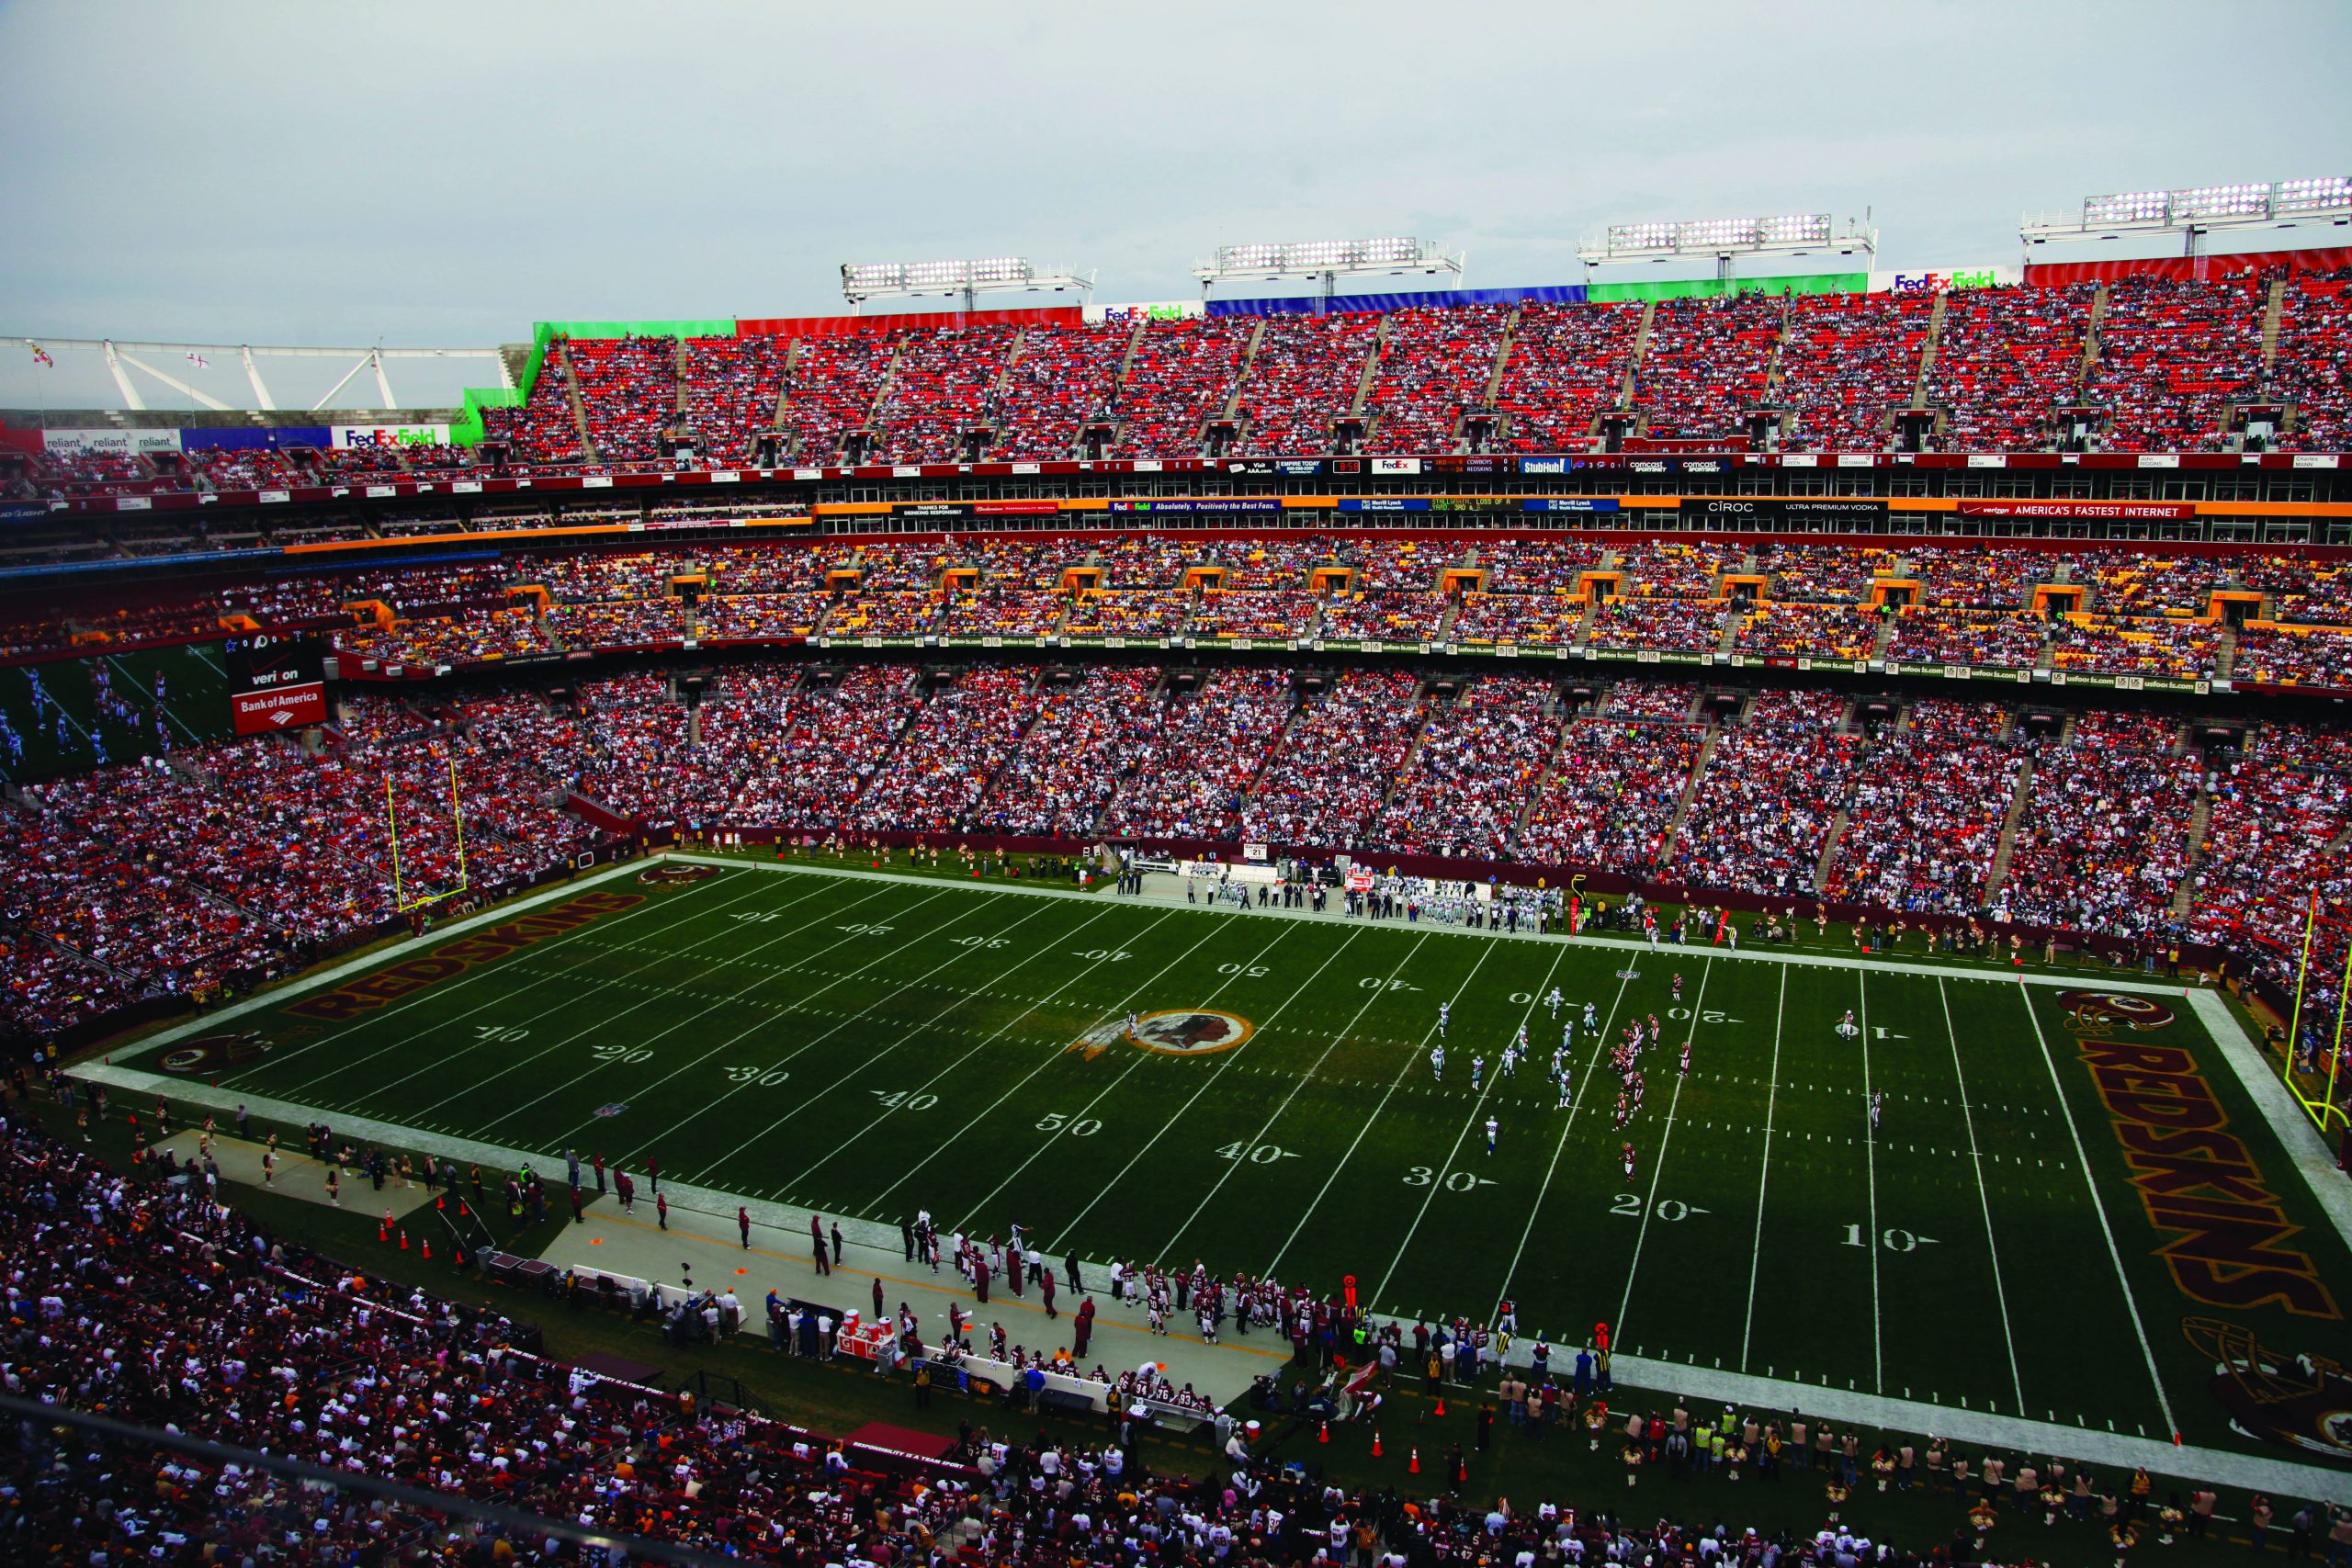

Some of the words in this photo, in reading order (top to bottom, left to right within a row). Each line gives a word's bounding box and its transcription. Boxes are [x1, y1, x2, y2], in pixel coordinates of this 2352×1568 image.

[1895, 270, 1995, 291] FedExField
[1105, 305, 1182, 321] FedExField
[47, 436, 81, 448] reliant
[94, 435, 128, 447] reliant
[139, 435, 171, 446] reliant
[346, 429, 435, 446] FedExField
[1382, 460, 1408, 469] FedEx
[1524, 458, 1566, 473] StubHub!
[1196, 502, 1228, 511] Positively
[1708, 501, 1753, 513] CÎROC
[2015, 505, 2070, 515] AMERICA'S
[2075, 506, 2121, 516] FASTEST
[2124, 507, 2178, 517] INTERNET
[241, 699, 266, 713] Bank
[267, 697, 278, 708] of
[278, 693, 318, 706] America
[288, 891, 647, 1021] REDSKINS
[478, 1026, 530, 1043] 10
[602, 1044, 654, 1065] 20
[728, 1067, 790, 1088] 30
[876, 1090, 939, 1111] 40
[1035, 1113, 1102, 1137] 50
[1214, 1141, 1283, 1164] 40
[1402, 1166, 1477, 1192] 30
[2078, 1038, 2343, 1319] REDSKINS
[1609, 1193, 1688, 1222] 20
[1839, 1223, 1917, 1252] 10
[1500, 1303, 1510, 1313] 3
[1136, 1383, 1148, 1395] 94
[1158, 1389, 1168, 1399] 76
[1180, 1394, 1192, 1405] 93
[853, 1440, 905, 1457] RESPONSIBILITY
[922, 1456, 941, 1465] TEAM
[942, 1459, 965, 1470] SPORT
[991, 1450, 1001, 1461] 21
[842, 1512, 853, 1523] 21
[1213, 1535, 1227, 1547] 68
